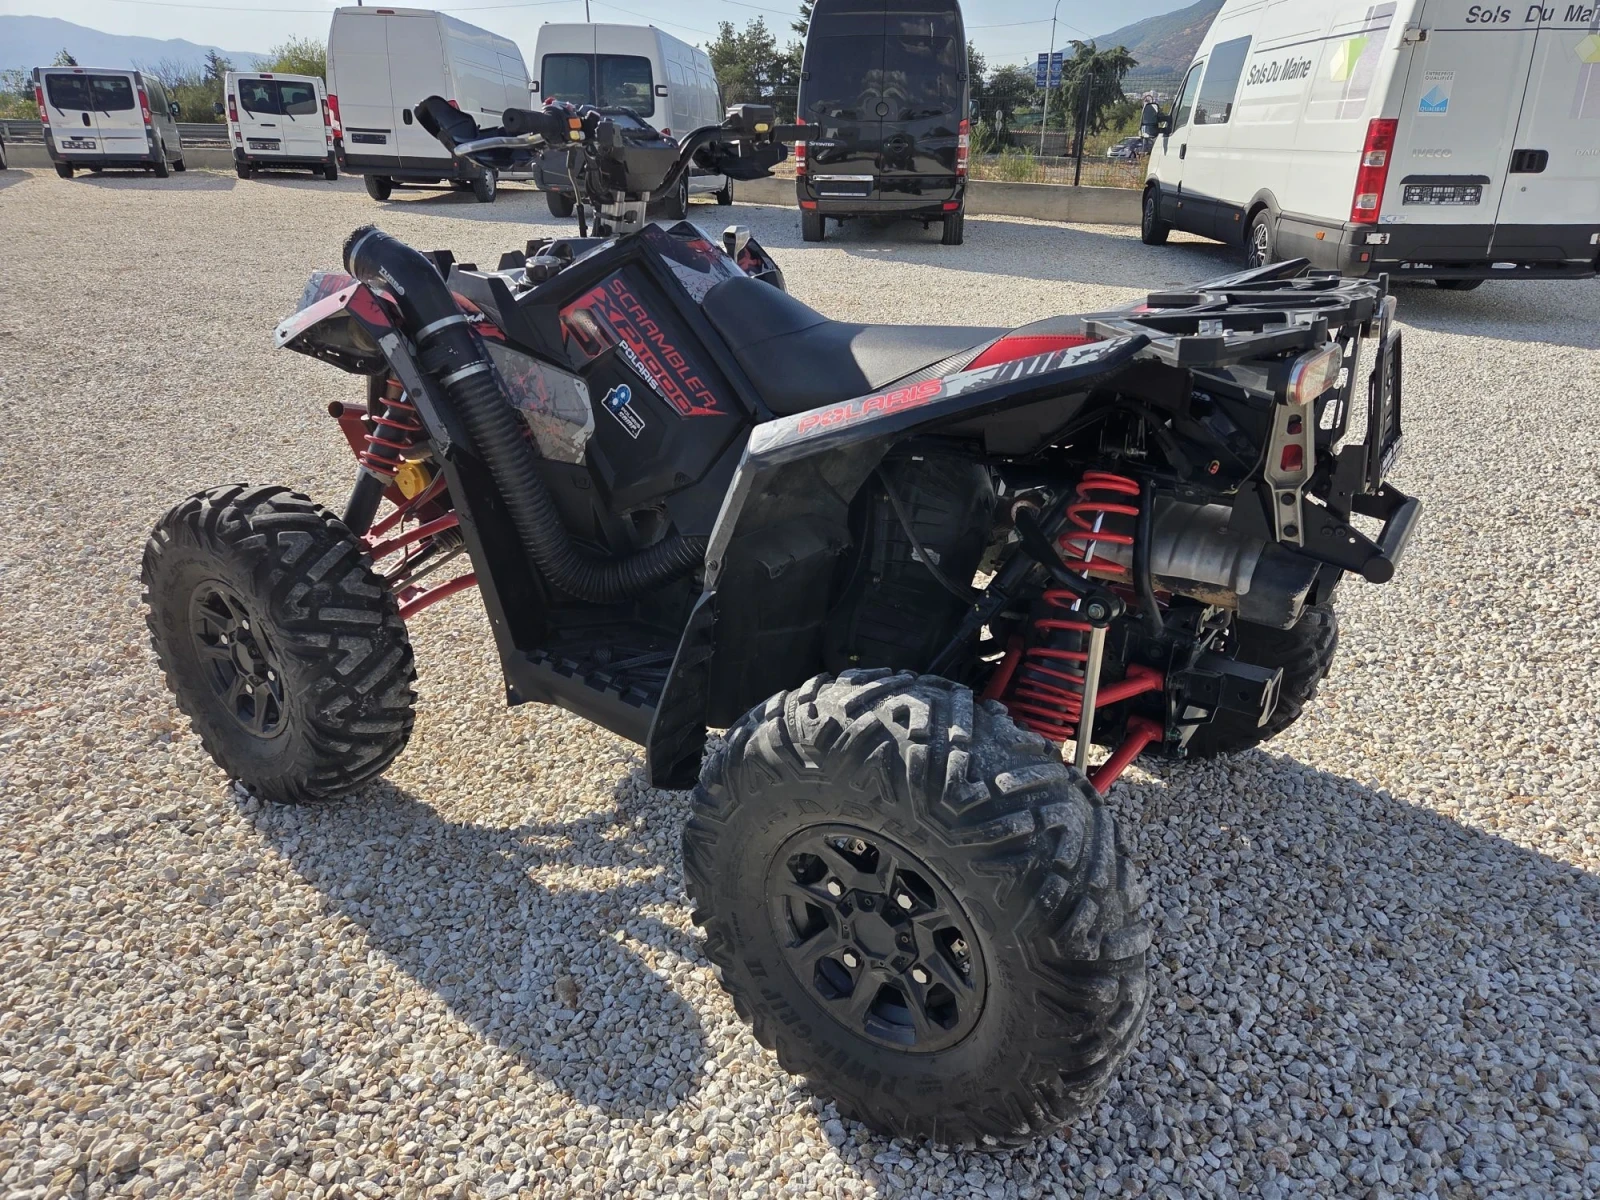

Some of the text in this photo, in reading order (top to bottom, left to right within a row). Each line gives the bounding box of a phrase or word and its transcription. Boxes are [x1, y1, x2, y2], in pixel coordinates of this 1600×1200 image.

[1465, 5, 1512, 24] Sols
[1524, 5, 1555, 23] Du
[1246, 55, 1312, 86] Sols Du Maine
[1412, 148, 1453, 158] IVECO
[608, 279, 717, 407] SCRAMBLER
[619, 339, 659, 391] POLARIS
[797, 379, 942, 434] POLARIS
